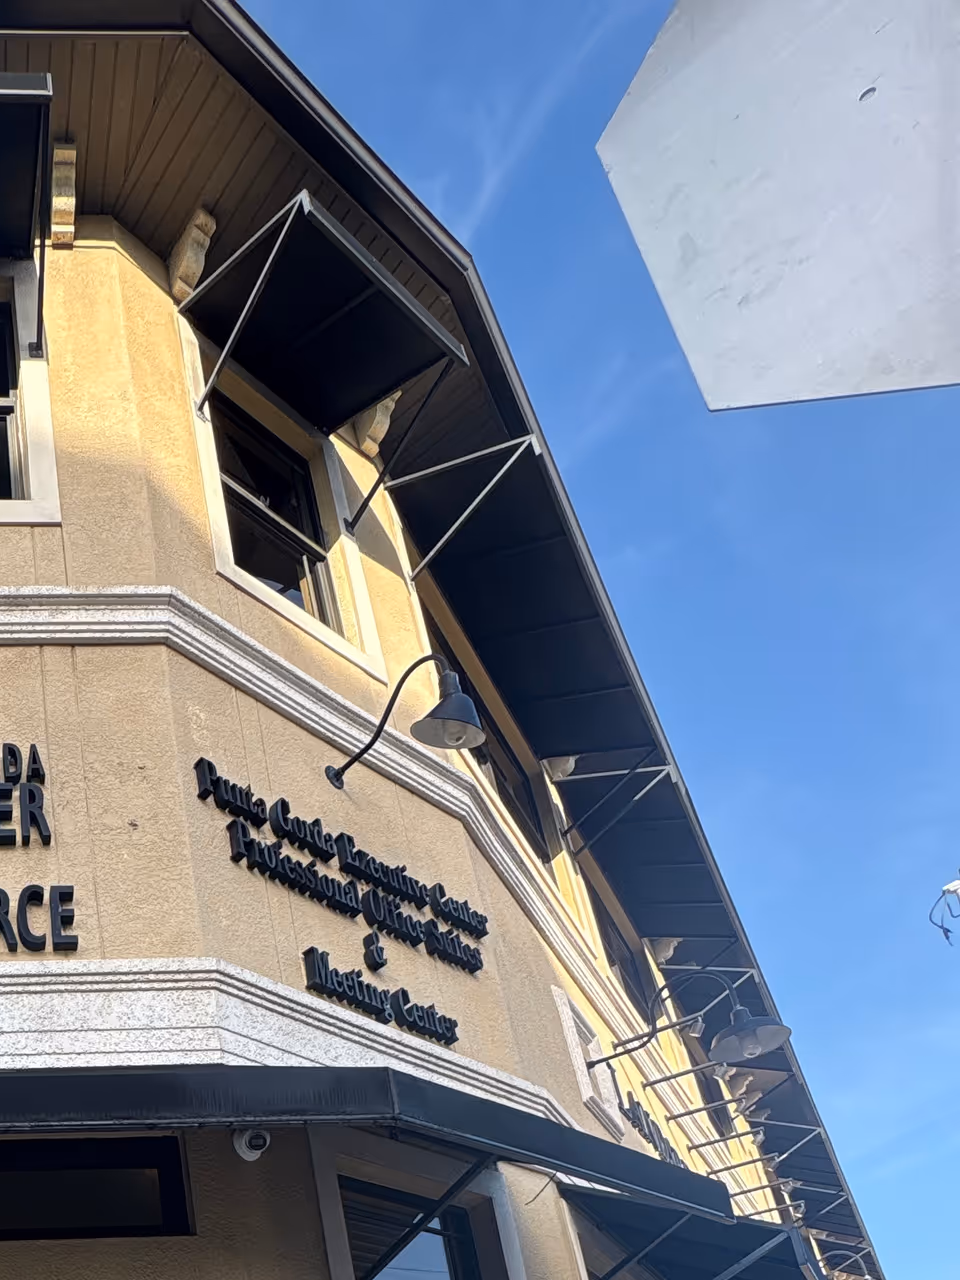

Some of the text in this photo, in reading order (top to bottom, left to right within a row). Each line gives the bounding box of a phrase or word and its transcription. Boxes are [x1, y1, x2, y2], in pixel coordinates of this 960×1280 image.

[193, 757, 489, 939] Punta Gorda Executive Center
[226, 818, 484, 974] Professional Office Suites
[302, 946, 459, 1046] Meeting Center
[363, 929, 388, 972] &
